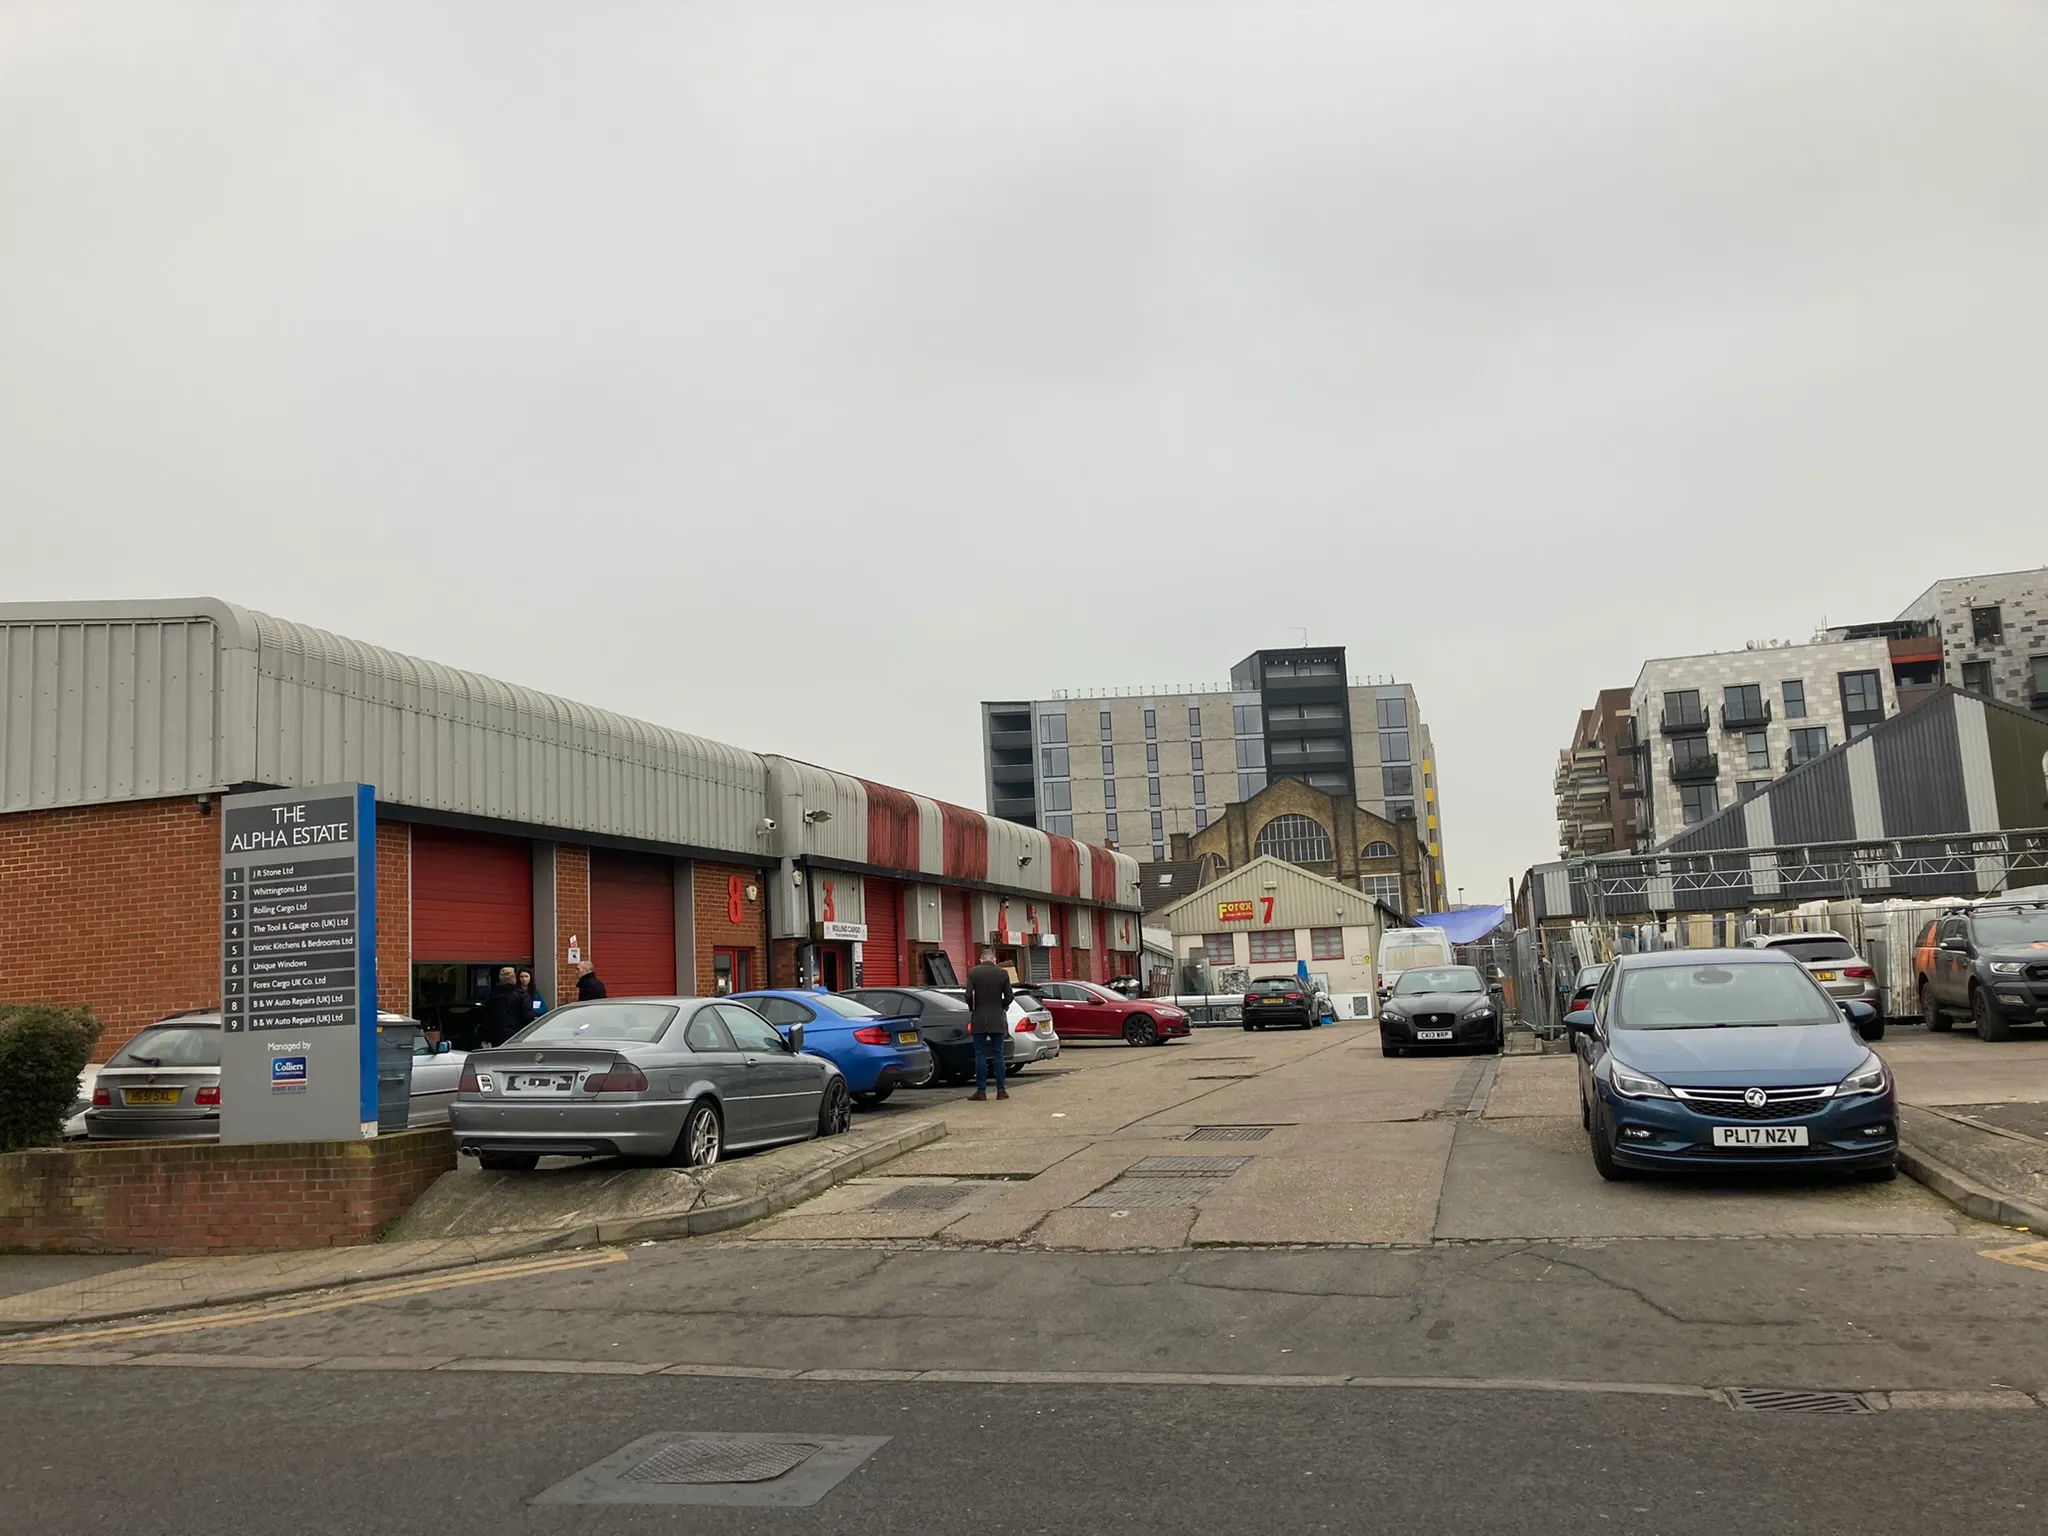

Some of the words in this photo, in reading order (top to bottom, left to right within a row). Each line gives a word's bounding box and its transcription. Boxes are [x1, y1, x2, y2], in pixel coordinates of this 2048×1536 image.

[272, 805, 306, 824] THE
[230, 829, 288, 851] ALPHA
[293, 823, 348, 845] ESTATE
[232, 872, 237, 881] 1
[252, 870, 256, 878] J
[256, 869, 262, 877] R
[263, 868, 281, 877] Stone
[282, 866, 294, 875] Ltd
[232, 890, 237, 900] 2
[253, 885, 295, 896] Whittingtons
[295, 884, 307, 893] Ltd
[729, 874, 743, 923] 8
[823, 880, 835, 922] 3
[232, 909, 237, 918] 3
[253, 906, 275, 916] Rolling
[276, 904, 295, 914] Cargo
[296, 903, 307, 912] Ltd
[1218, 901, 1252, 919] Forex
[1260, 897, 1274, 924] 7
[231, 927, 237, 936] 4
[253, 925, 265, 933] The
[266, 922, 281, 932] Tool
[282, 922, 287, 930] &
[288, 921, 309, 931] Gauge
[321, 918, 336, 928] (UK)
[337, 917, 348, 926] Ltd
[847, 925, 861, 933] CARGO
[232, 945, 237, 954] 5
[253, 942, 272, 951] Iconic
[273, 940, 300, 950] Kitchens
[301, 940, 307, 948] &
[308, 938, 340, 947] Bedrooms
[341, 936, 353, 945] Ltd
[231, 963, 237, 973] 6
[253, 960, 276, 971] Unique
[277, 959, 307, 968] Windows
[231, 983, 237, 992] 7
[253, 980, 271, 989] Forex
[271, 979, 291, 989] Cargo
[291, 978, 301, 986] UK
[302, 977, 314, 986] Co.
[315, 976, 326, 985] Ltd
[231, 1001, 237, 1011] 8
[253, 1000, 258, 1008] B
[258, 999, 265, 1008] &
[265, 998, 273, 1007] W
[274, 997, 291, 1006] Auto
[291, 996, 315, 1006] Repairs
[316, 995, 331, 1005] (UK)
[331, 994, 343, 1003] Ltd
[231, 1020, 237, 1030] 9
[253, 1019, 258, 1027] B
[258, 1018, 265, 1027] &
[265, 1017, 273, 1026] W
[274, 1016, 291, 1025] Auto
[291, 1015, 315, 1025] Repairs
[316, 1014, 331, 1024] (UK)
[331, 1013, 343, 1022] Ltd
[268, 1041, 301, 1052] Managed
[302, 1041, 312, 1051] by
[275, 1061, 304, 1072] Colliers
[1724, 1129, 1760, 1143] PL17
[1765, 1129, 1797, 1143] NZV
